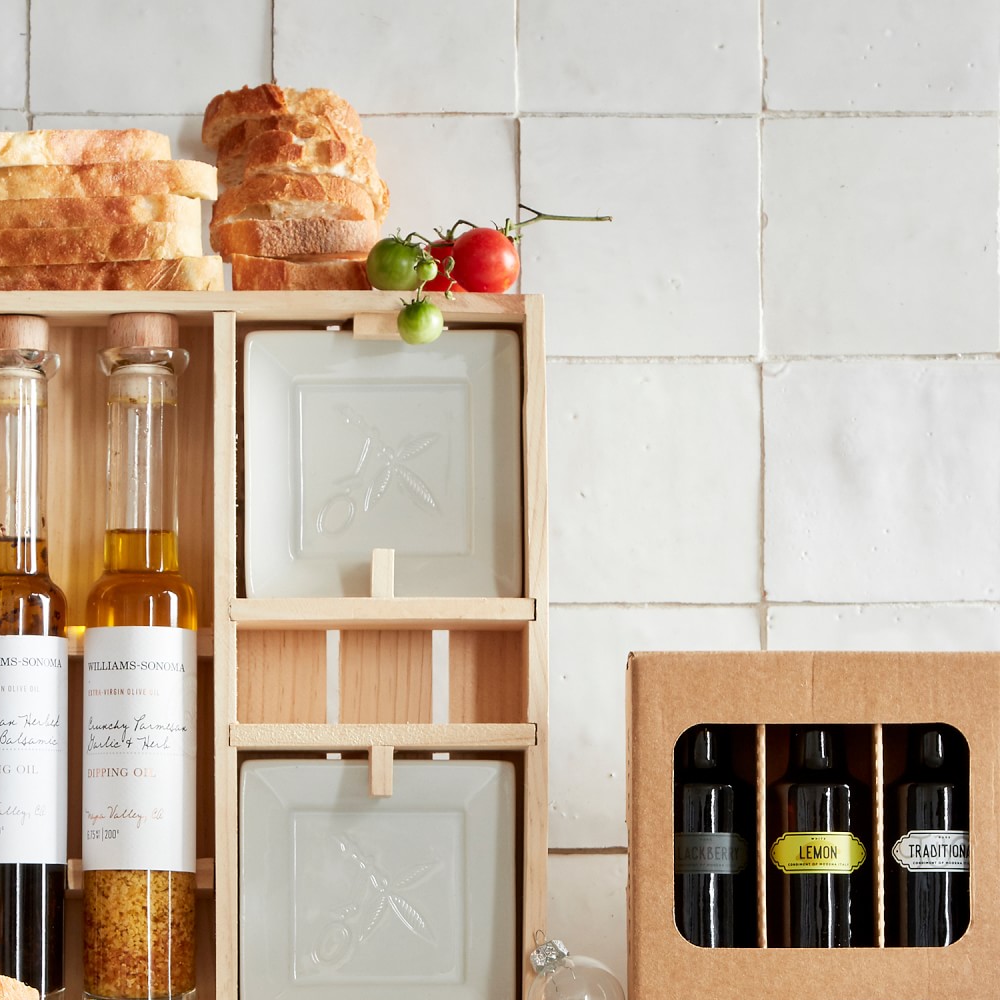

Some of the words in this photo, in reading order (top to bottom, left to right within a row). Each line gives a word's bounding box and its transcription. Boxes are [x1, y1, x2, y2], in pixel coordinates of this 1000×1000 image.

[88, 661, 186, 673] WILLIAMS-SONOMA
[8, 685, 27, 693] OLIVE
[29, 685, 40, 693] OIL
[88, 688, 125, 697] EXTRA-VIRGIN
[127, 688, 146, 696] OLIVE
[88, 716, 130, 736] Crunchy
[133, 713, 188, 732] Parmesan
[88, 736, 121, 751] Garlic
[125, 738, 133, 748] &
[136, 736, 170, 750] Herb
[16, 764, 39, 775] OIL
[88, 767, 129, 778] DIPPING
[133, 767, 157, 777] OIL
[799, 845, 838, 860] LEMON
